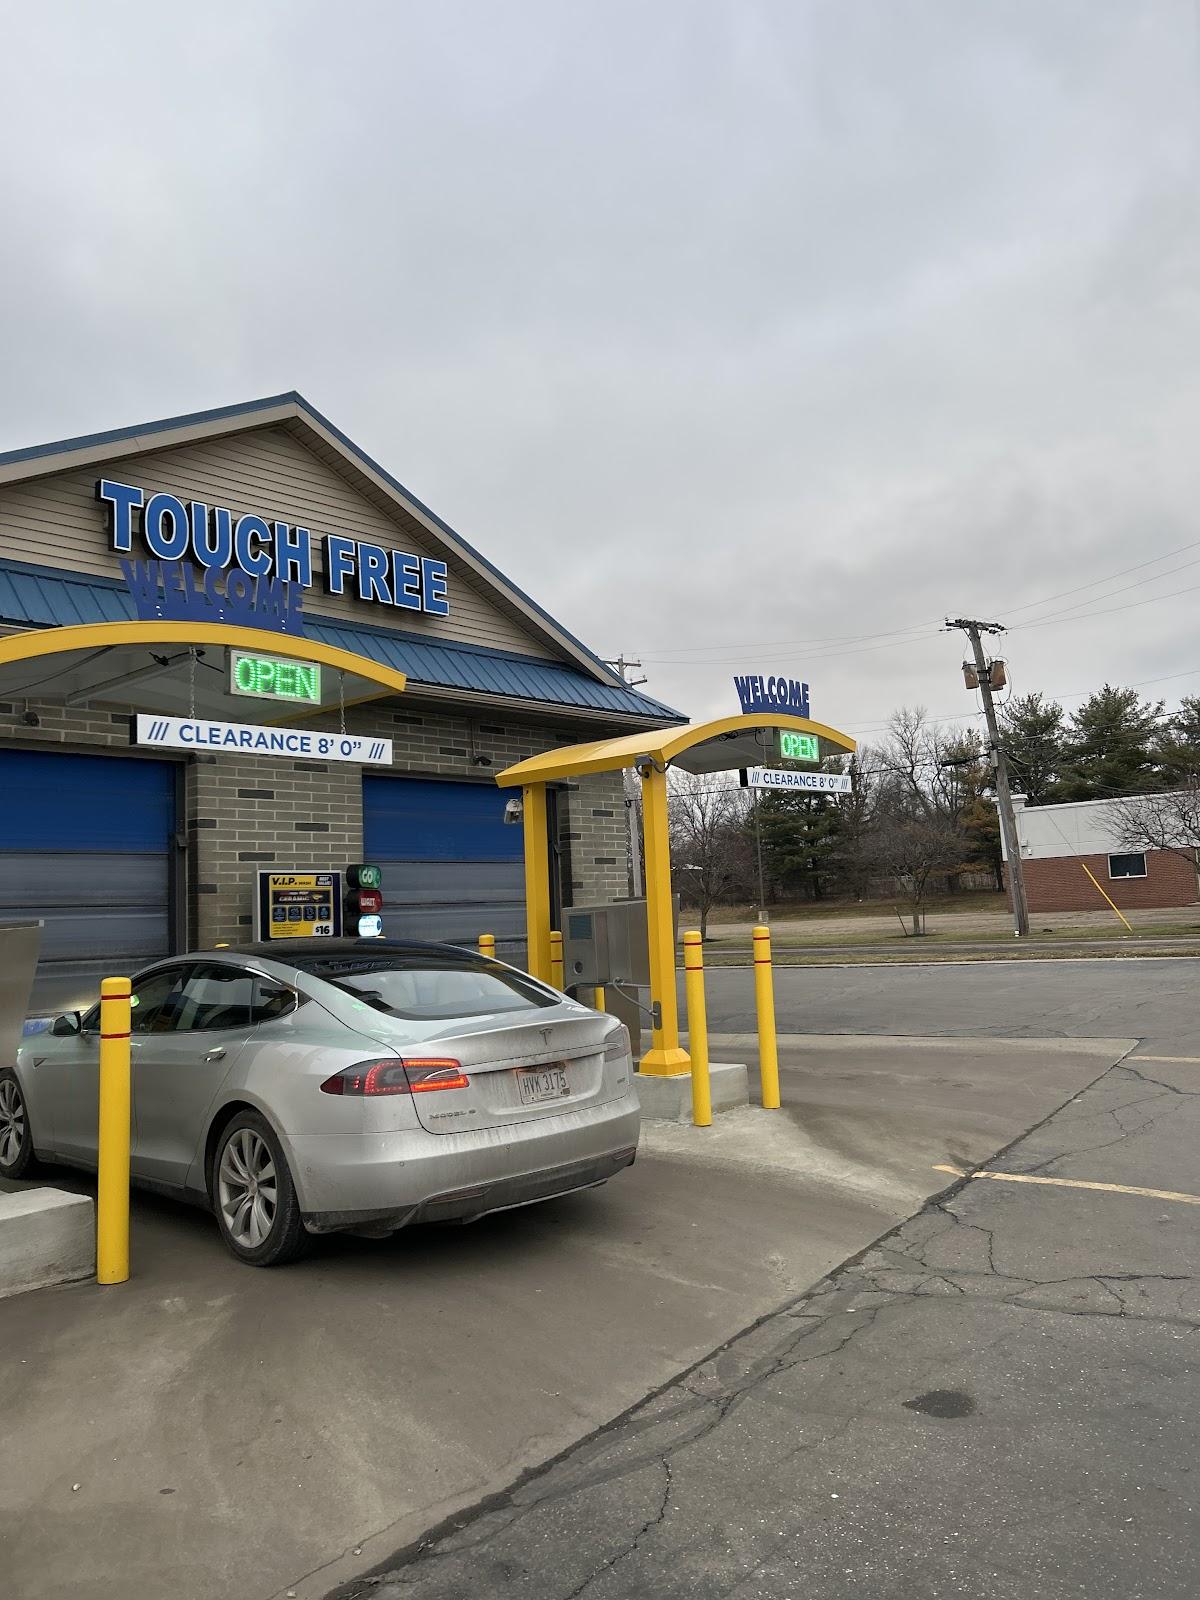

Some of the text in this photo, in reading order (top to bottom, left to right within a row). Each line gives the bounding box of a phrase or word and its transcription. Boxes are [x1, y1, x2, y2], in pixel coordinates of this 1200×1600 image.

[98, 478, 450, 616] TOUCH FREE
[120, 559, 303, 620] WELCOME
[233, 656, 318, 701] OPEN
[734, 676, 809, 706] WELCOME
[178, 724, 311, 754] CLEARANCE
[782, 734, 817, 759] OPEN
[763, 772, 817, 787] CLEARANCE
[272, 877, 297, 886] V.I.P.
[362, 869, 373, 883] GO
[360, 897, 376, 907] WAIT
[315, 925, 330, 935] $16
[522, 1071, 567, 1095] HVK 3175
